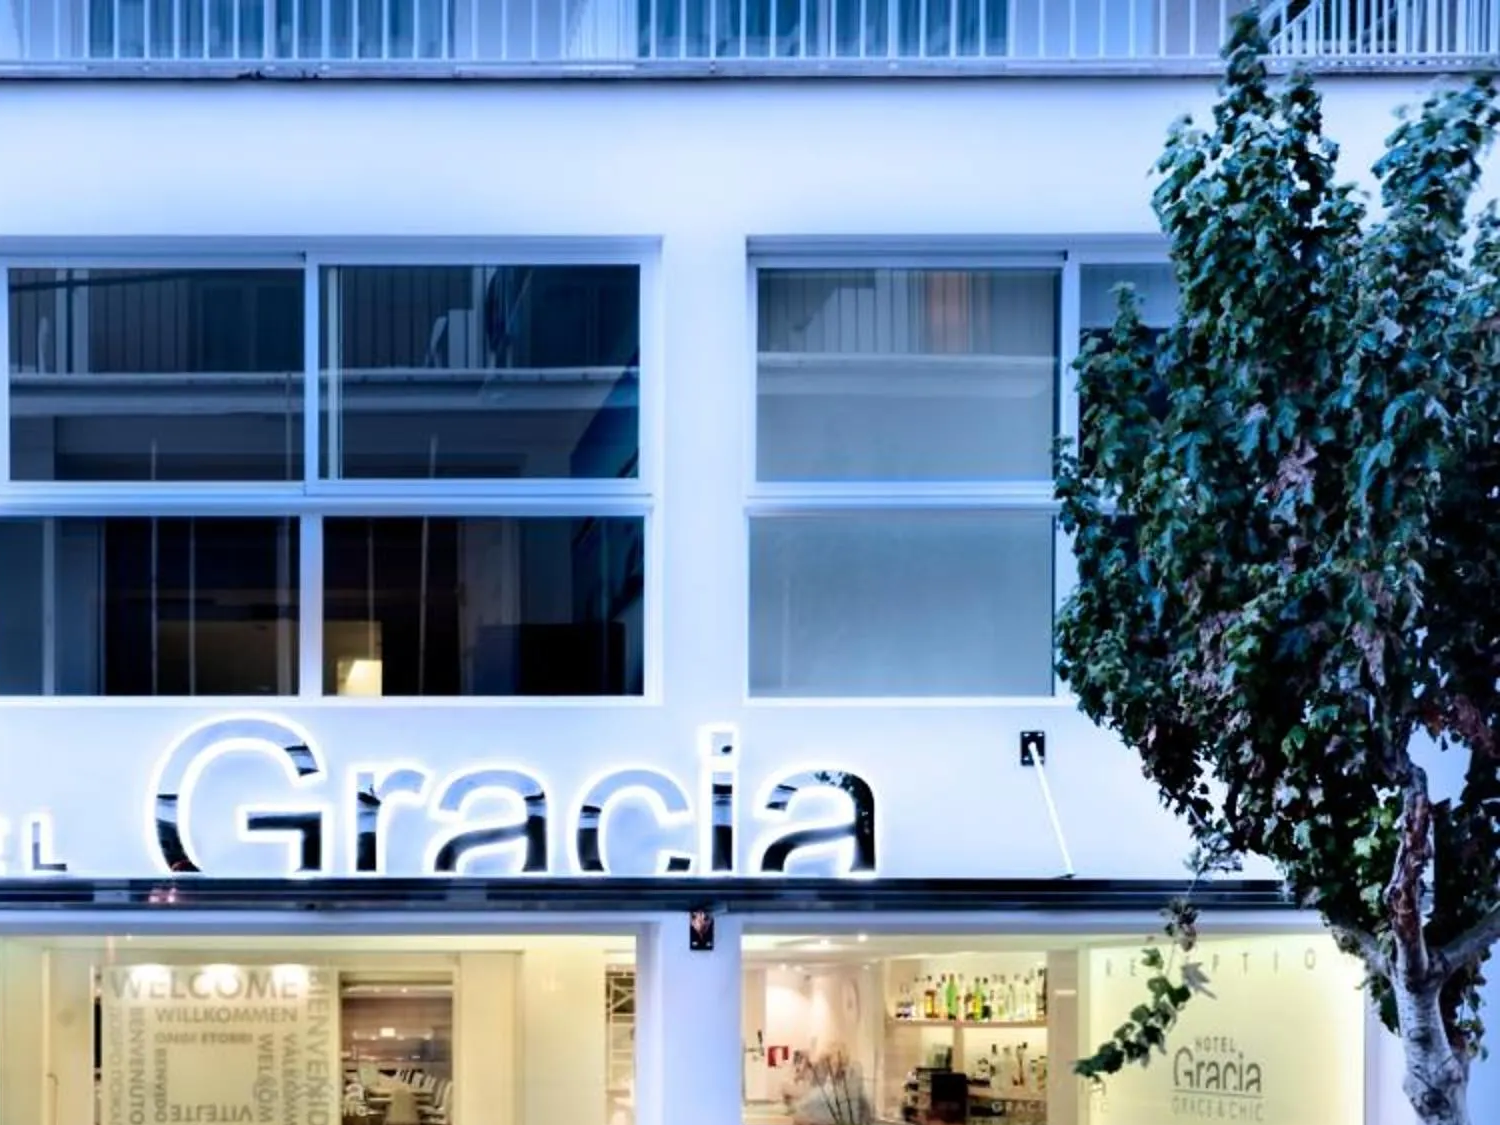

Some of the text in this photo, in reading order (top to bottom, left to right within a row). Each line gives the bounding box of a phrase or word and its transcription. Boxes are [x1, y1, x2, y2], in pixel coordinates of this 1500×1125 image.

[156, 717, 878, 873] Gracia
[1105, 947, 1358, 978] REPTIO
[110, 970, 299, 999] WELCOME
[155, 1006, 298, 1023] WILLKOMMEN
[1195, 1036, 1236, 1053] HOTEL
[1173, 1046, 1262, 1093] Gracia
